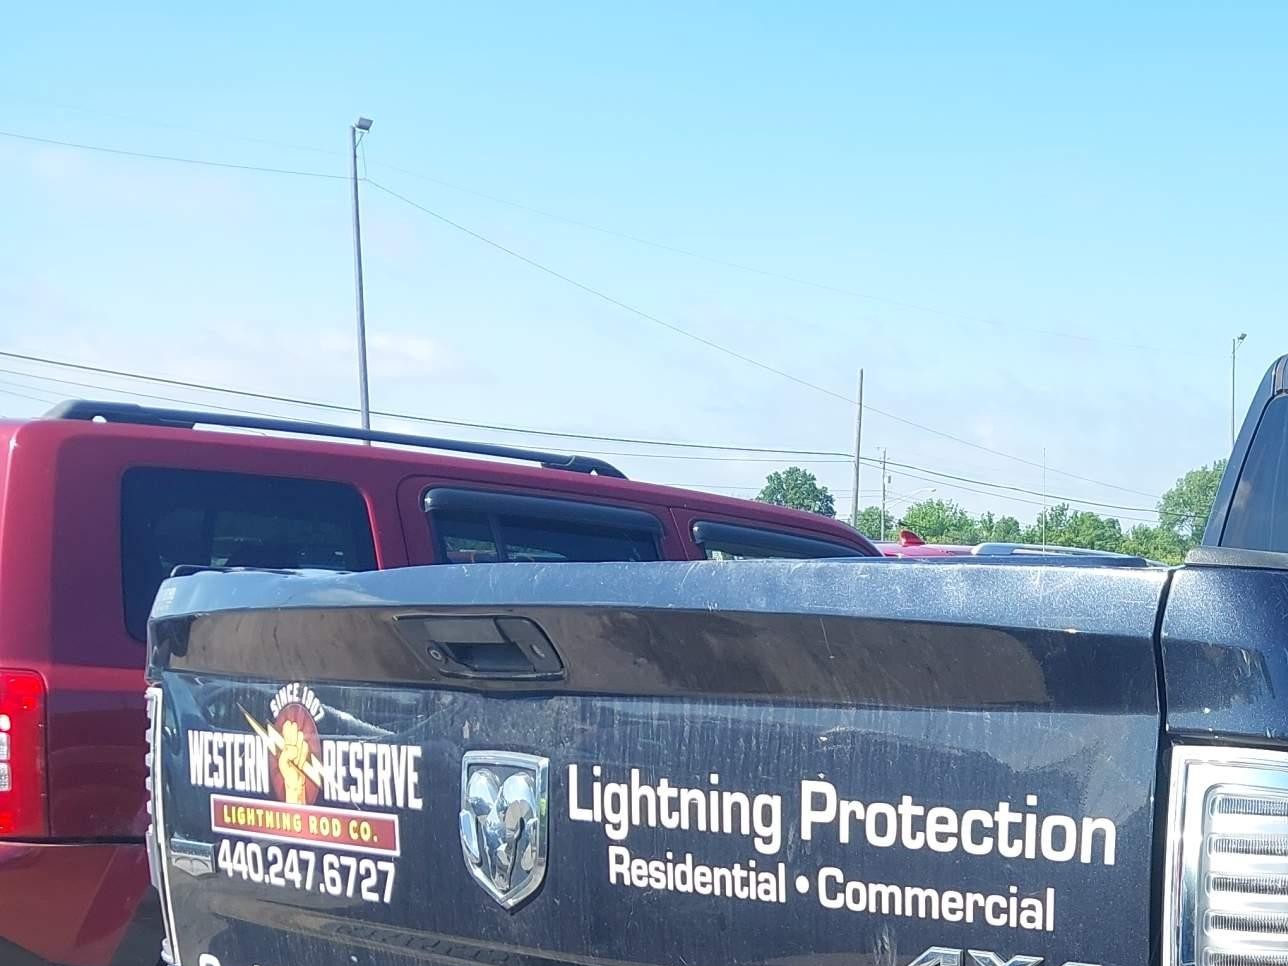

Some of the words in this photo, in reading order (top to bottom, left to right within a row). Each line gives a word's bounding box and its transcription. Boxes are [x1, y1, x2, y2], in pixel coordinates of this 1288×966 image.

[270, 682, 300, 718] SINCE
[188, 730, 270, 794] WESTERN
[322, 743, 423, 811] RESERVE
[223, 804, 303, 832] LIGHTNING
[308, 818, 343, 837] ROD
[349, 823, 379, 843] CO.
[567, 763, 782, 855] Lightning
[800, 778, 1117, 866] Protection
[217, 838, 396, 904] 440.247.6727
[607, 846, 788, 904] Residential
[817, 866, 1056, 932] Commercial
